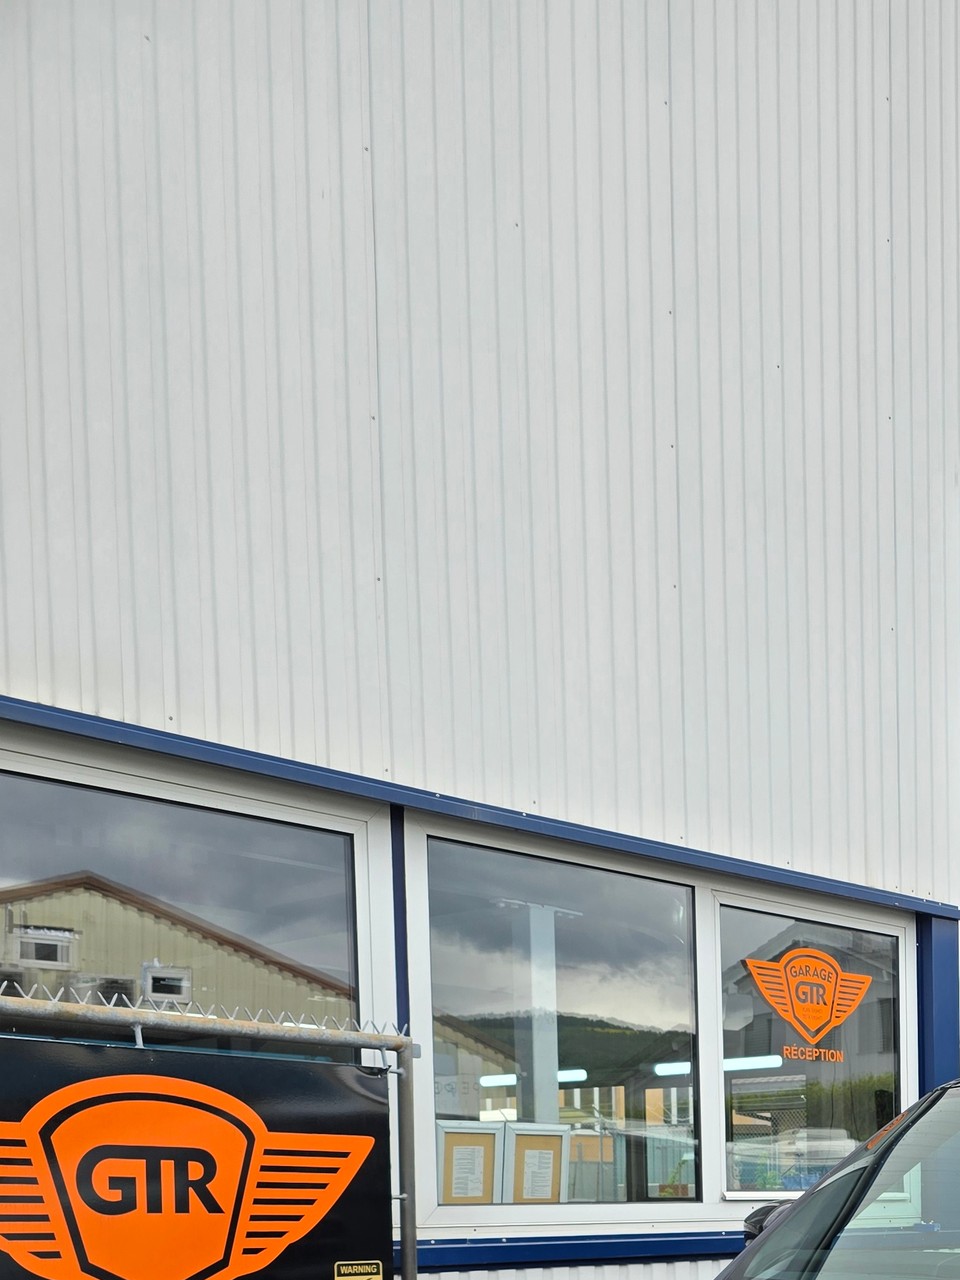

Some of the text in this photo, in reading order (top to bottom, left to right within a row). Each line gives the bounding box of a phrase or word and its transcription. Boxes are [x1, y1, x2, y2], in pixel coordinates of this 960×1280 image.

[789, 964, 833, 983] GARAGE
[795, 980, 828, 1006] GTR
[783, 1043, 844, 1062] RÉCEPTION
[75, 1144, 225, 1216] GTR
[340, 1265, 377, 1274] WARNING
